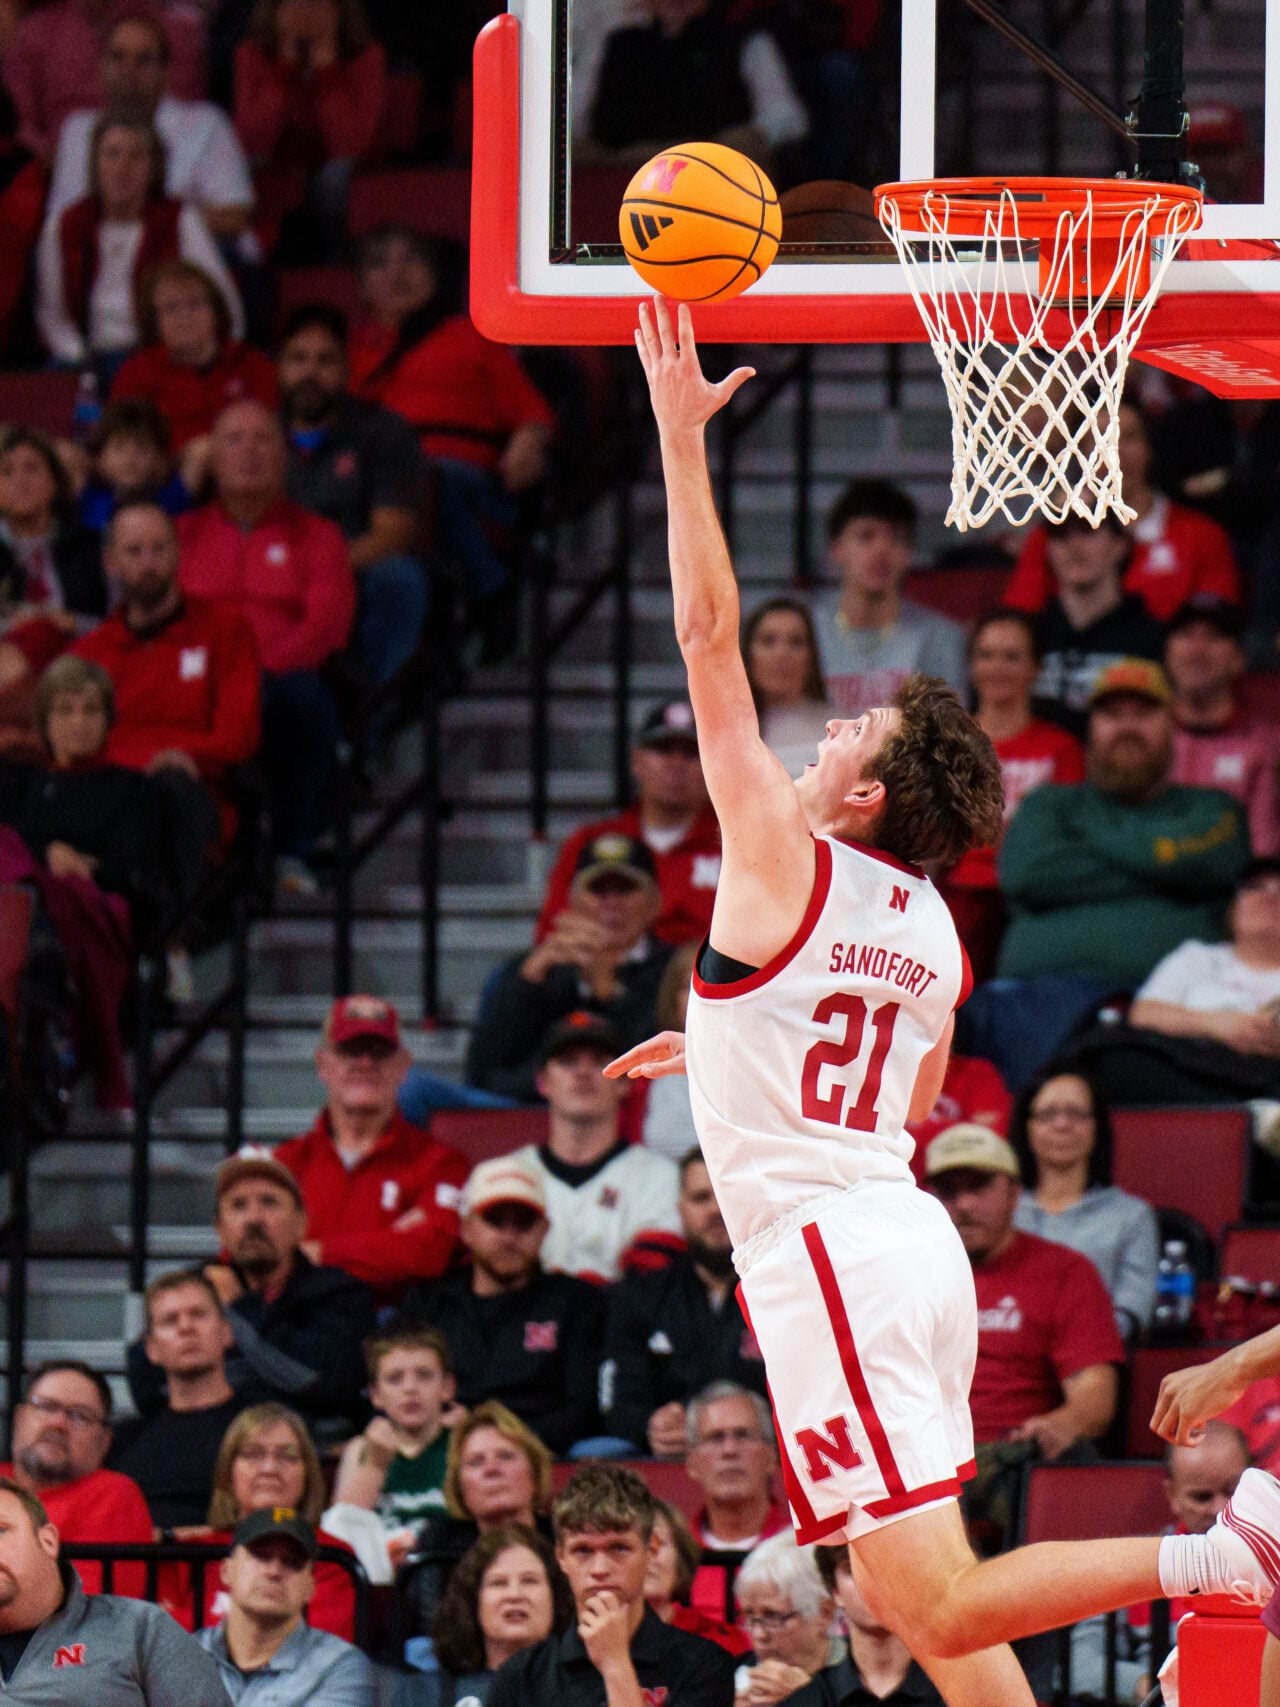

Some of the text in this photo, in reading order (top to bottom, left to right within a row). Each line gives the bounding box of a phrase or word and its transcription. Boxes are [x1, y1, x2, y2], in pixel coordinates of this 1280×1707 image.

[640, 158, 689, 195] N
[888, 884, 910, 914] N
[828, 942, 938, 998] SANDFORT
[801, 991, 901, 1133] 21
[793, 1412, 866, 1484] N
[53, 1643, 88, 1670] N
